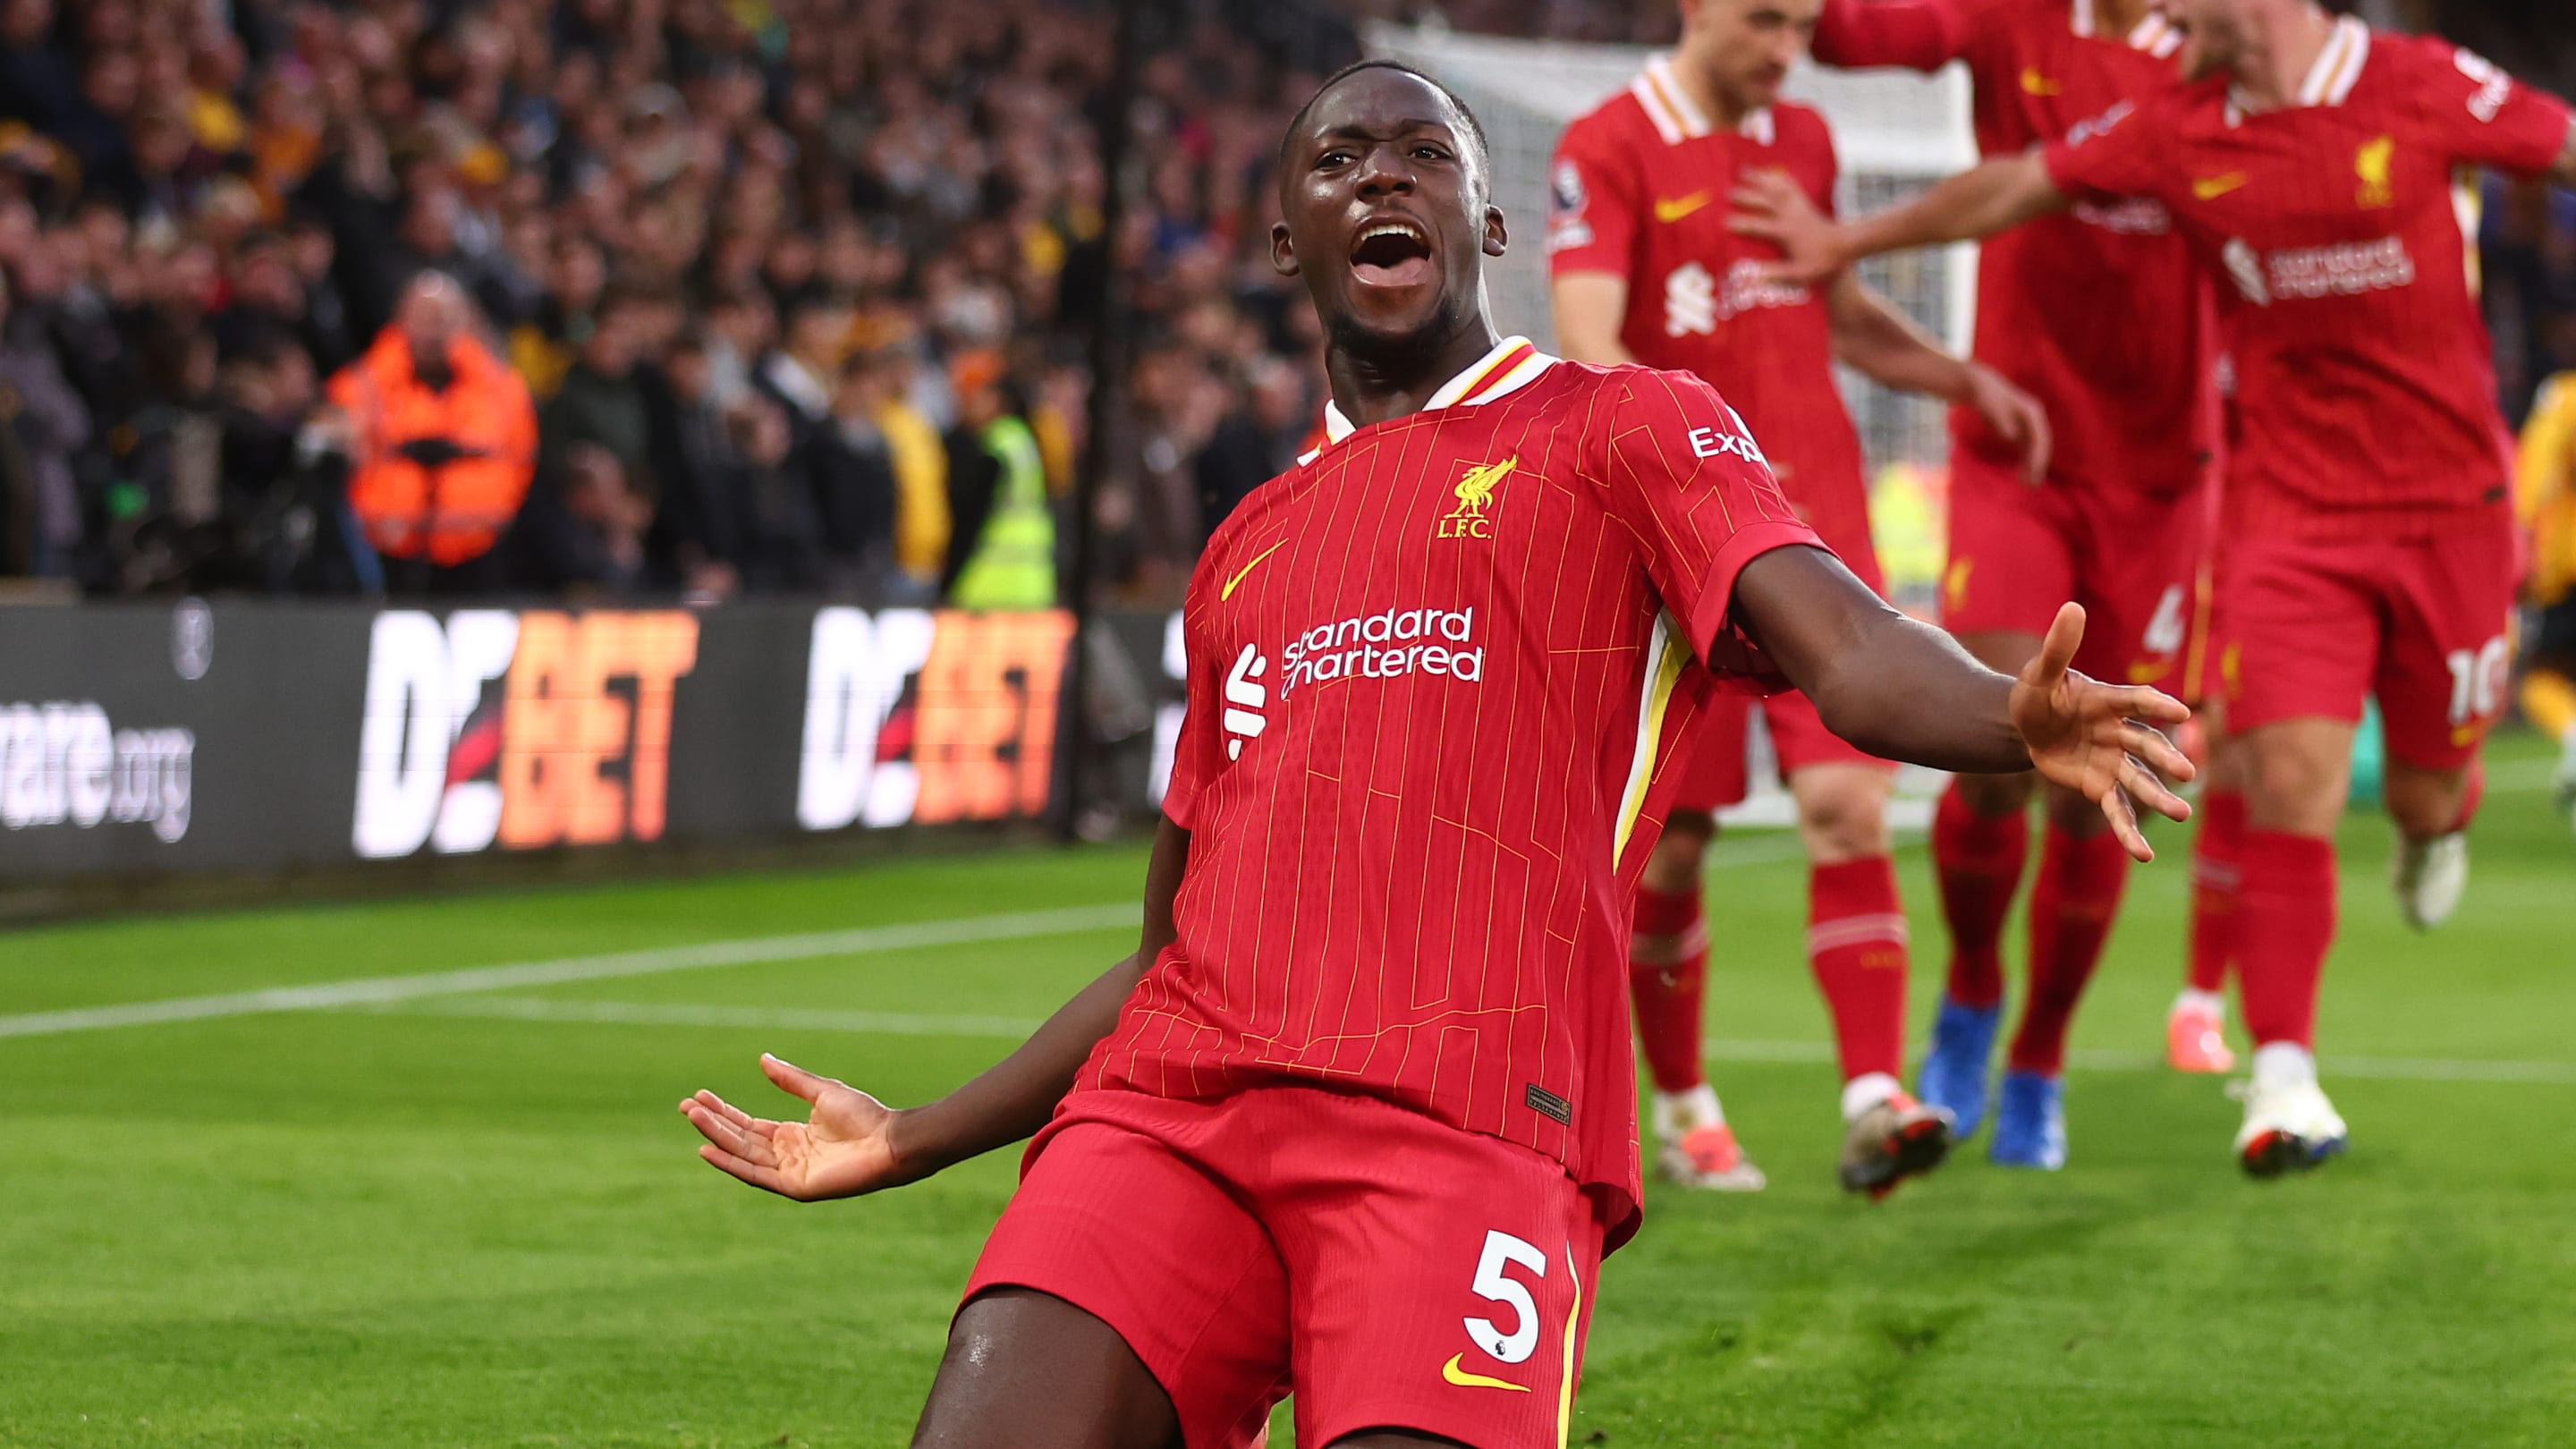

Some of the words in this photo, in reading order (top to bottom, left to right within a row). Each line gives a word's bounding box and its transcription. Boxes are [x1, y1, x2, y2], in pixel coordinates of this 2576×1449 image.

[1688, 427, 1773, 474] Exp
[1436, 519, 1492, 539] L.F.C.
[1284, 606, 1473, 671] standard
[2446, 636, 2508, 725] 10
[1463, 1229, 1546, 1364] 5
